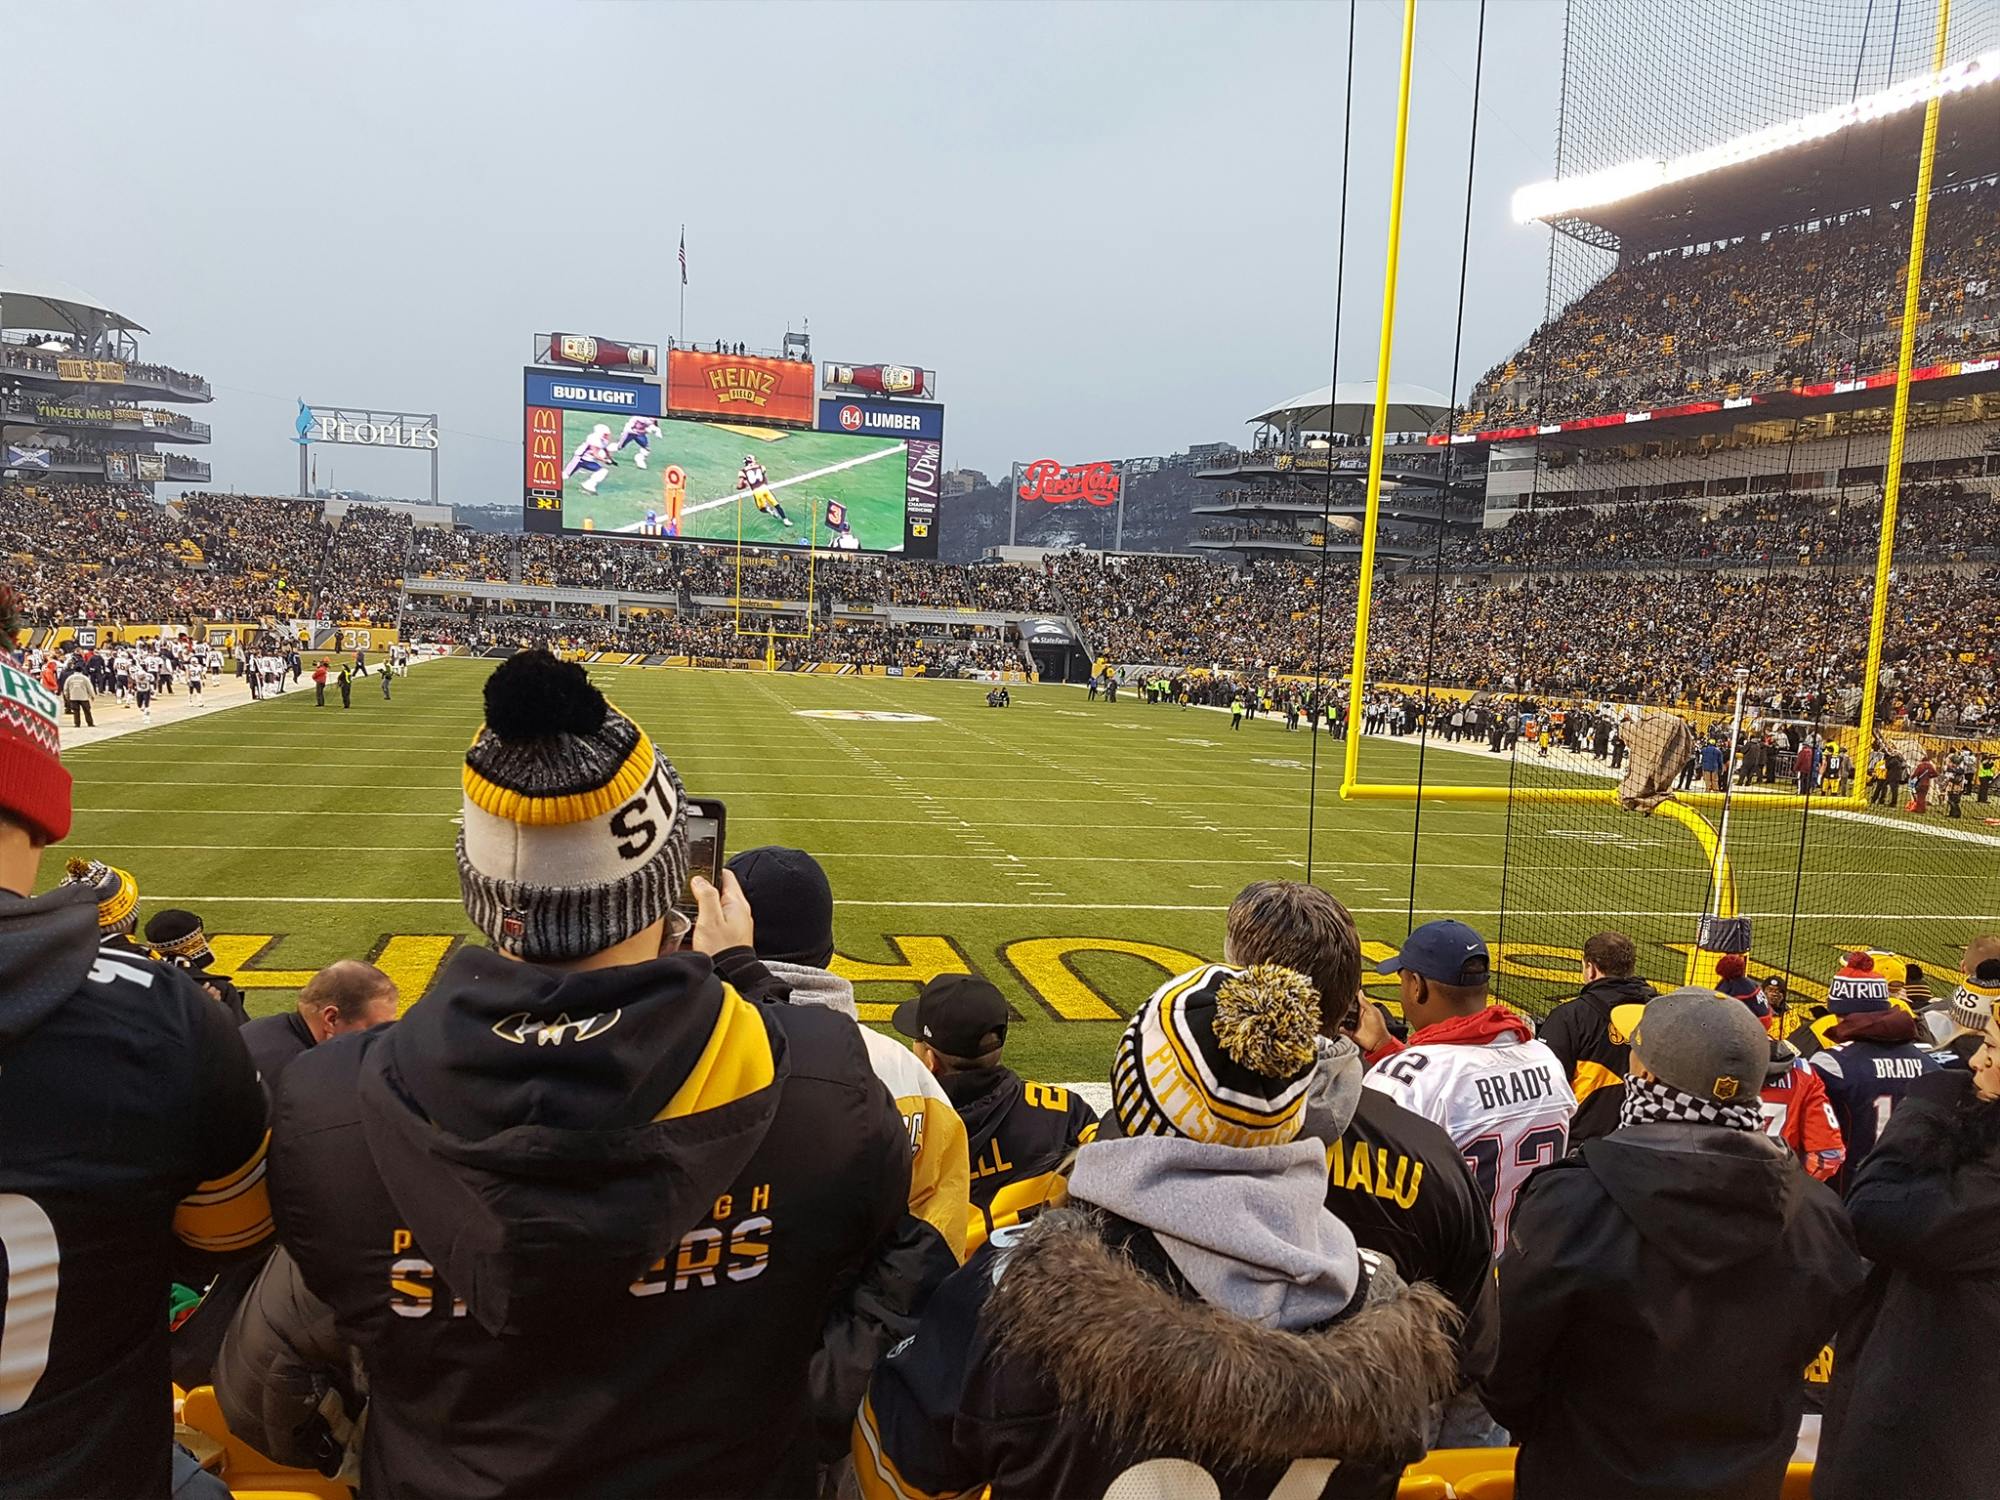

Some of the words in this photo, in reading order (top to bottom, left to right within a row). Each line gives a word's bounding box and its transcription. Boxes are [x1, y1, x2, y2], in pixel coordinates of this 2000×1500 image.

[553, 385, 587, 400] BUD
[588, 389, 635, 405] LIGHT
[708, 368, 775, 394] HEINZ
[732, 389, 752, 400] FIELD
[36, 405, 84, 419] YINZER
[842, 410, 860, 426] 84
[865, 412, 921, 431] LUMBER
[321, 417, 440, 449] PEOPLES
[908, 443, 940, 488] UPMC
[344, 630, 372, 650] 33
[0, 664, 57, 718] RS
[610, 762, 676, 860] ST
[1955, 988, 1979, 1009] RS
[1376, 1053, 1431, 1087] 12
[1873, 1058, 1923, 1079] BRADY
[1475, 1066, 1553, 1111] BRADY
[1760, 1102, 1788, 1136] 7
[1822, 1102, 1839, 1130] 8
[1873, 1095, 1893, 1143] 1
[1327, 1136, 1424, 1210] MALU
